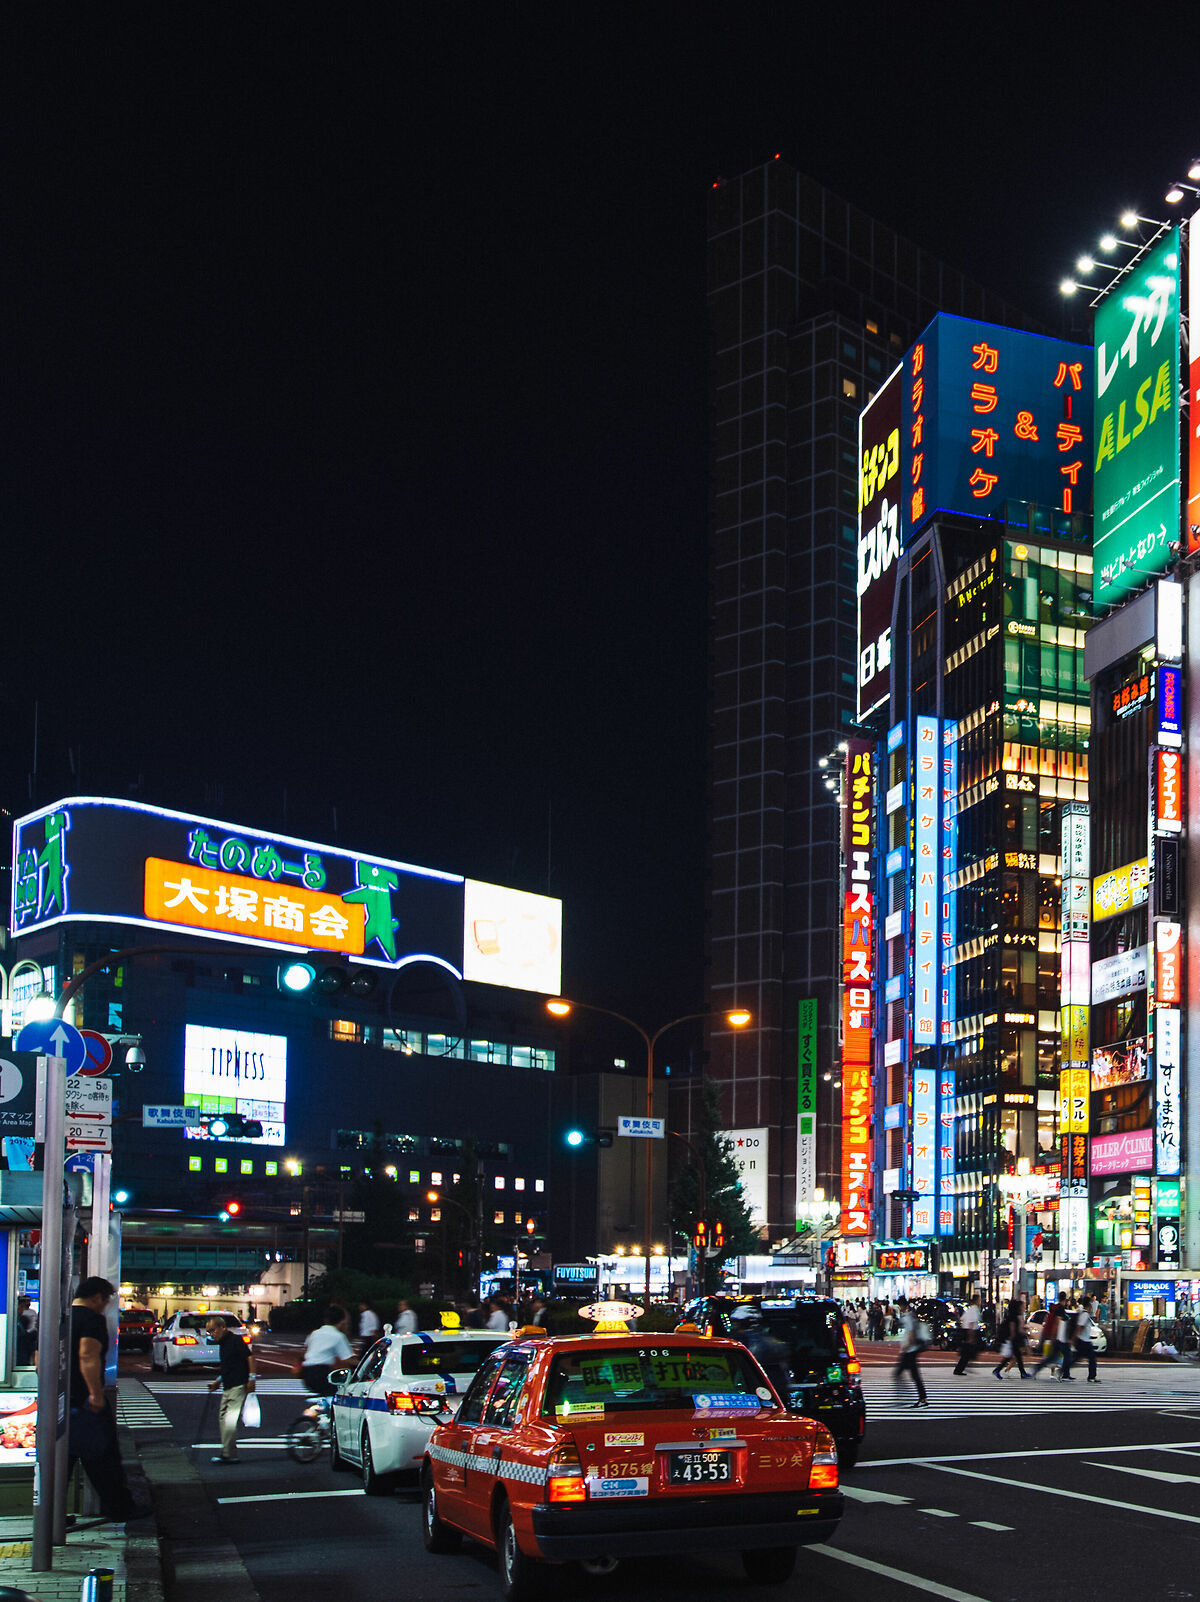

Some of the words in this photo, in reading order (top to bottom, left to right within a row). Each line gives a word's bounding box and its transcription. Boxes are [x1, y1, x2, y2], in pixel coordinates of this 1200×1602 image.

[1097, 251, 1178, 399] レイク
[969, 342, 999, 498] カラオケ
[1014, 411, 1039, 441] &
[1053, 362, 1083, 514] パーティー
[1095, 359, 1171, 474] ALSA
[858, 428, 899, 514] パチンコ
[857, 498, 899, 598] エスパス
[1164, 672, 1175, 719] PROMISE
[852, 752, 871, 846] パチンコ
[188, 829, 327, 891] たのめーる
[164, 878, 349, 940] 大塚商会
[850, 851, 871, 981] エスパス
[67, 1080, 80, 1089] 22
[211, 1041, 265, 1086] TIPNESS
[801, 1033, 811, 1110] すぐ買える
[70, 1128, 82, 1136] 20
[98, 1128, 104, 1136] 7
[148, 1108, 195, 1119] 歌舞伎町
[622, 1119, 661, 1131] 歌舞伎町
[850, 1069, 868, 1144] パチンコ
[1160, 1062, 1176, 1148] すしまみれ
[917, 1080, 933, 1225] カラオケ館
[556, 1266, 597, 1279] FUYUTSUKI
[1134, 1282, 1170, 1290] SUBNADE
[683, 1463, 728, 1481] 43-53
[684, 1455, 701, 1463] 足立
[702, 1454, 718, 1462] 500
[759, 1455, 803, 1468] 三ツ矢
